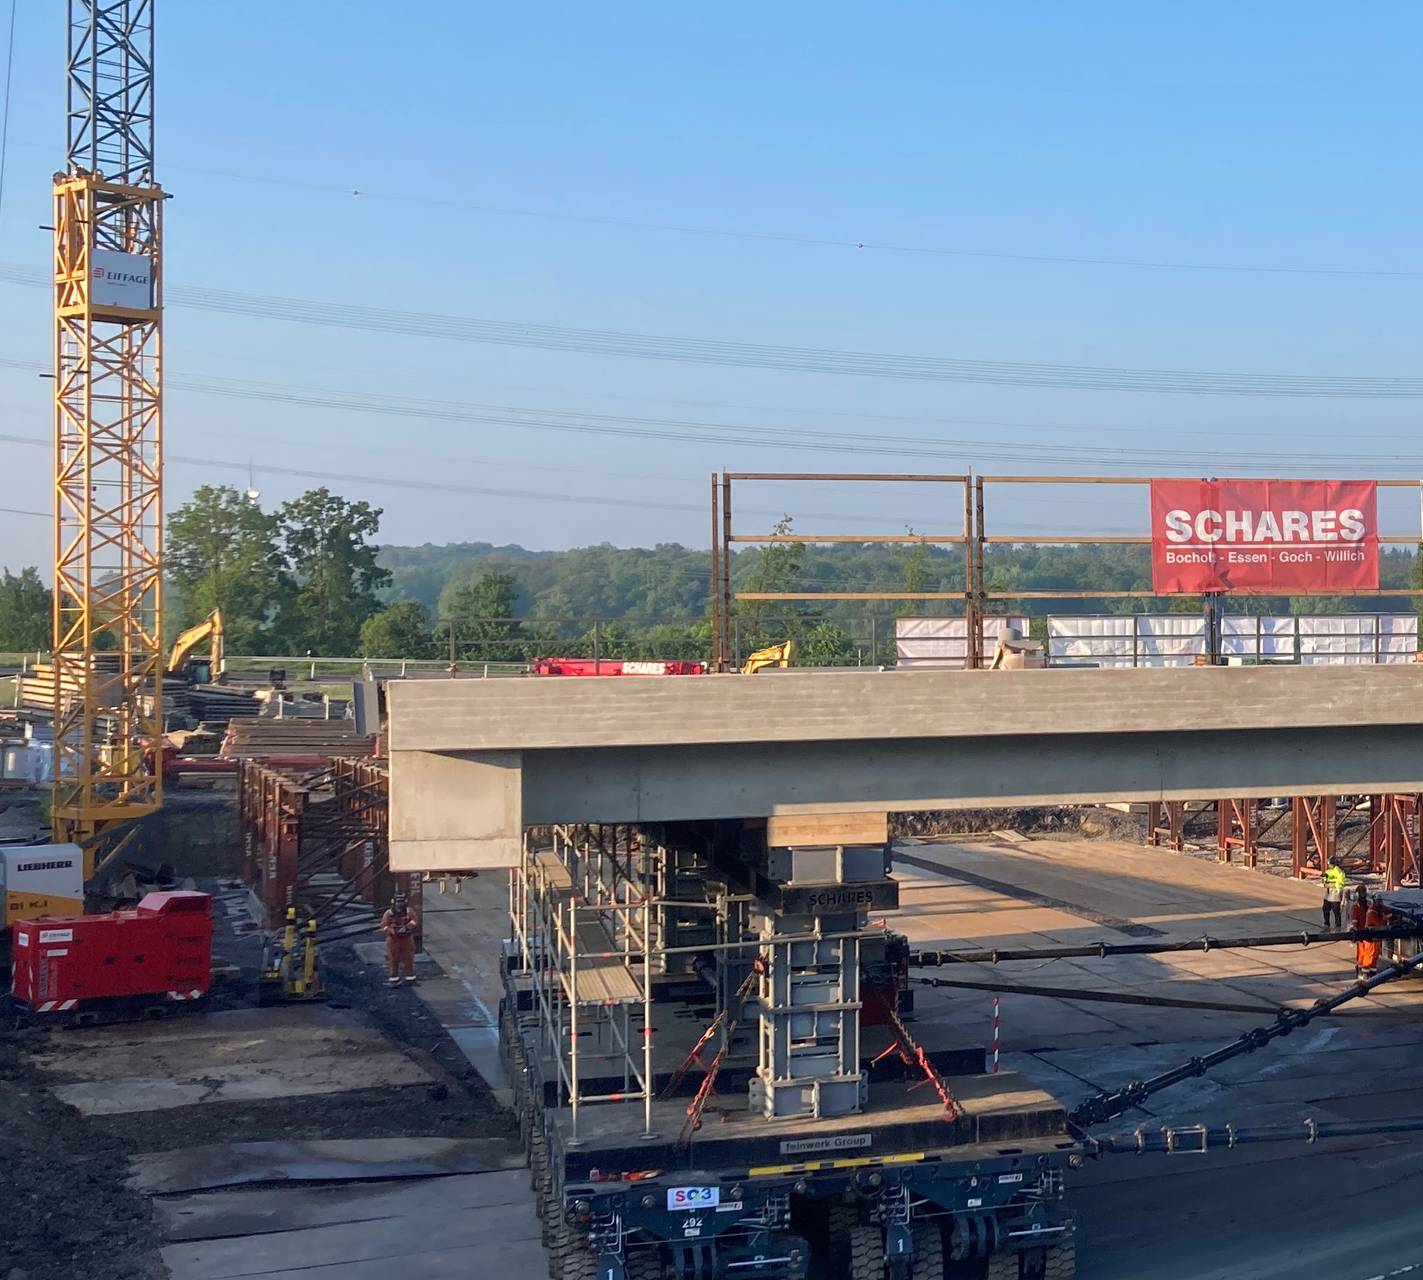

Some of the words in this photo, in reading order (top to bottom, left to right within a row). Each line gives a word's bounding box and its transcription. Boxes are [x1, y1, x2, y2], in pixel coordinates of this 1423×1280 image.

[107, 271, 149, 285] EIFFAGE
[1165, 509, 1366, 542] SCHARES
[1228, 551, 1267, 563] Essen
[1279, 551, 1313, 563] Goch
[1324, 550, 1365, 562] Willich
[17, 860, 73, 872] LIEBHERR
[410, 872, 421, 896] EHL
[809, 889, 873, 906] SCHARES
[834, 1136, 866, 1147] Group
[682, 1217, 704, 1229] 292
